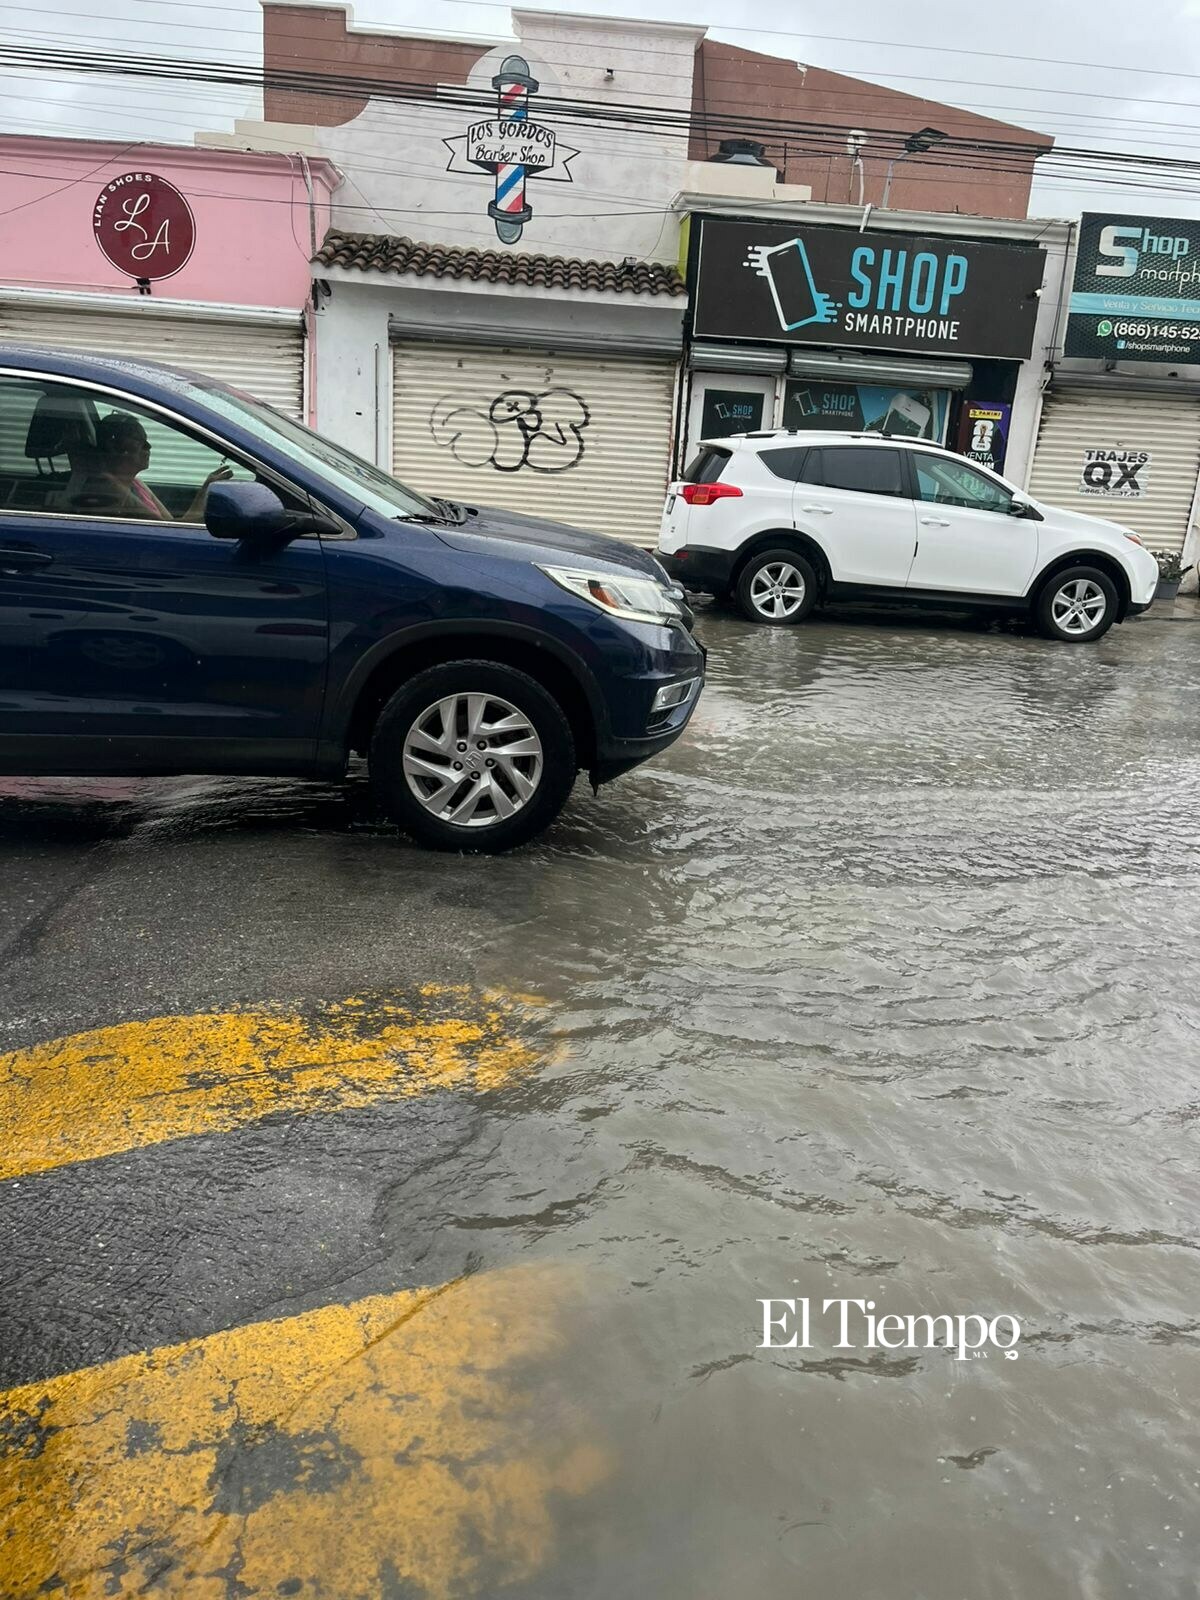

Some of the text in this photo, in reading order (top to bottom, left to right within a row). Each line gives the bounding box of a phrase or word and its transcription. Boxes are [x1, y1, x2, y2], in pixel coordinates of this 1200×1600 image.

[470, 122, 493, 144] LOS
[475, 144, 545, 164] Barber Shop
[94, 173, 152, 227] LIAN SHOES
[848, 246, 968, 315] SHOP
[1103, 299, 1129, 310] Venta
[1132, 302, 1138, 311] y
[844, 312, 960, 340] SMARTPHONE
[732, 404, 753, 416] SHOP
[823, 393, 855, 411] SHOP
[963, 451, 994, 461] VENTA
[1085, 450, 1149, 463] TRAJES
[1083, 461, 1144, 491] QX
